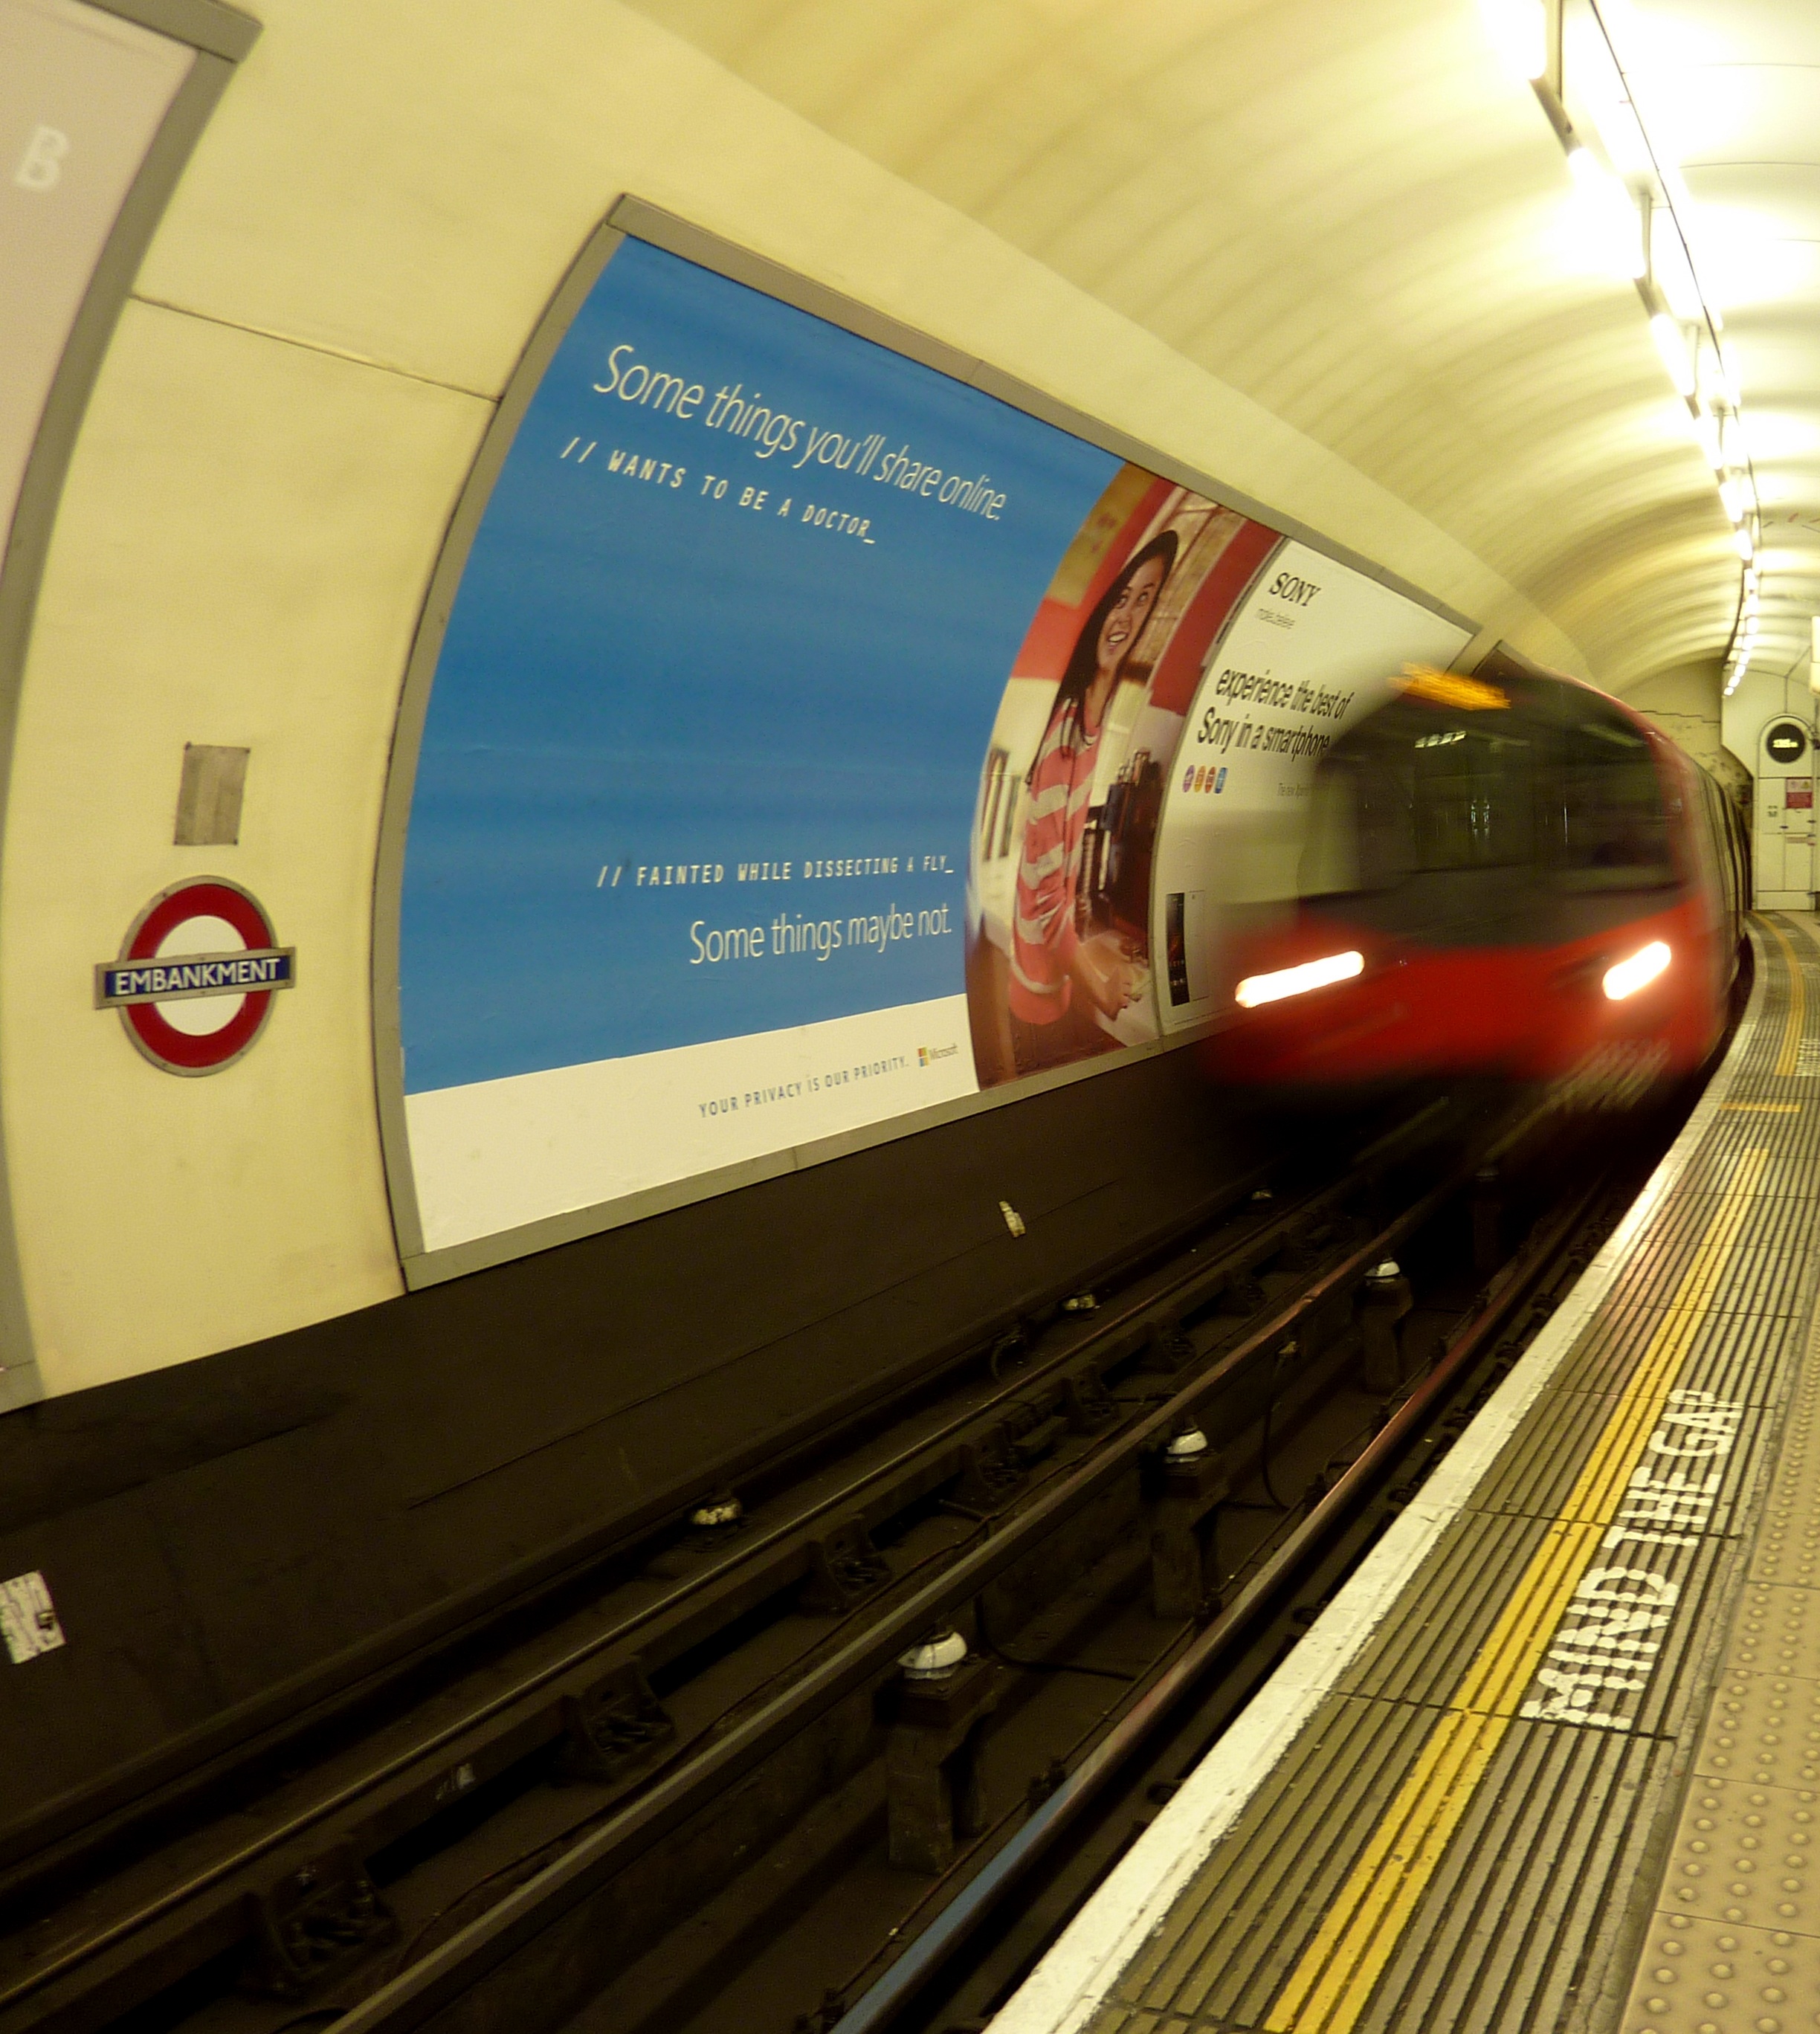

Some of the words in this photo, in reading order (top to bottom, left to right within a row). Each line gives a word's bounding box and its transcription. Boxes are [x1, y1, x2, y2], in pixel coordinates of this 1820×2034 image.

[594, 344, 704, 419] Some
[706, 384, 805, 459] things
[793, 426, 886, 476] you'll
[874, 445, 941, 497] share
[938, 474, 1007, 521] online.
[607, 450, 686, 488] WANTS
[701, 474, 729, 500] TO
[739, 487, 769, 511] BE
[778, 498, 793, 518] A
[1268, 572, 1321, 607] SONY
[1216, 668, 1294, 708] experience
[1290, 679, 1314, 712] the
[1310, 684, 1341, 717] best
[1335, 691, 1355, 720] of
[1198, 706, 1239, 754] Sony
[1236, 713, 1253, 748] in
[1251, 725, 1265, 749] a
[1262, 724, 1331, 762] smartphone
[636, 864, 724, 886] FAINTED
[738, 862, 793, 882] WHILE
[804, 856, 898, 879] DISSECTING
[906, 856, 914, 872] A
[690, 920, 764, 964] Some
[771, 913, 842, 961] things
[847, 903, 914, 953] maybe
[917, 903, 952, 937] not.
[114, 958, 280, 995] EMBANKMENT
[698, 1095, 739, 1118] YOUR
[744, 1081, 803, 1108] PRIVACY
[807, 1077, 820, 1094] IS
[825, 1071, 850, 1088] OUR
[853, 1056, 909, 1081] PRIORITY.
[1648, 1389, 1743, 1457] GAP
[1602, 1466, 1723, 1549] THE
[1519, 1566, 1679, 1730] MIND
